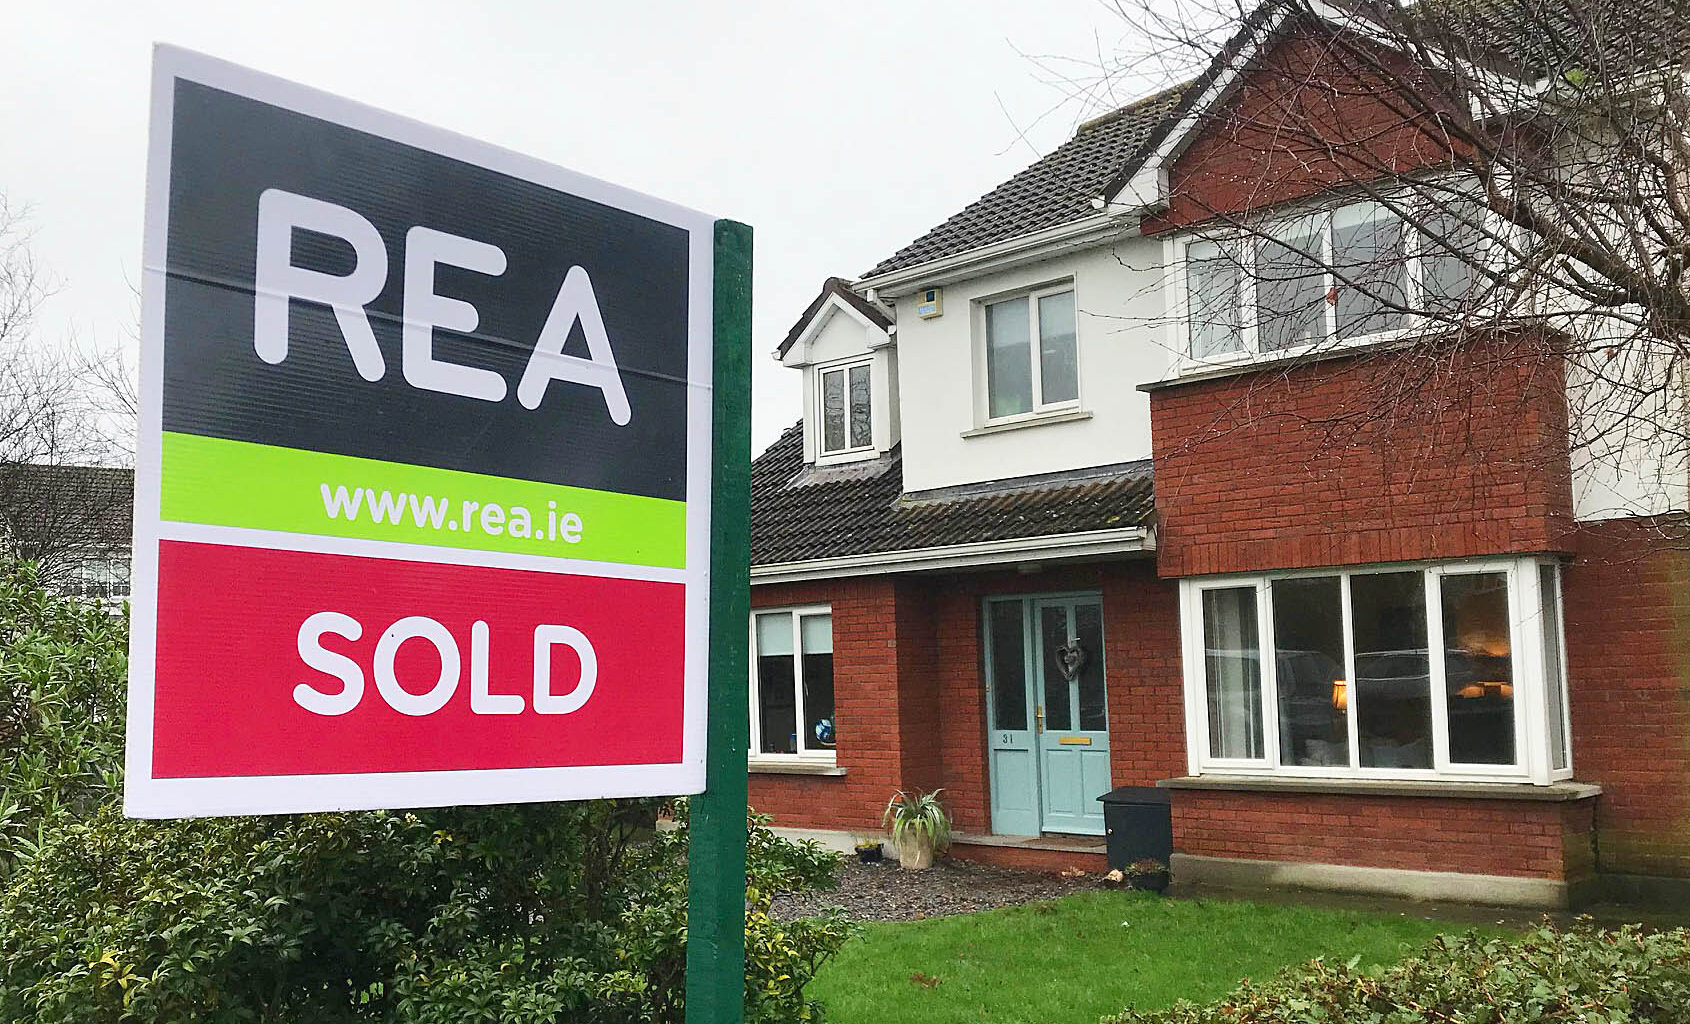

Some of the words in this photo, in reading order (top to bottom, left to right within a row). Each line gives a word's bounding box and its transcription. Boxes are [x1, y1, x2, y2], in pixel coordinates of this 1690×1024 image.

[253, 188, 632, 426] REA
[319, 483, 584, 544] www.rea.ie
[292, 611, 598, 716] SOLD
[1002, 733, 1014, 745] 31
